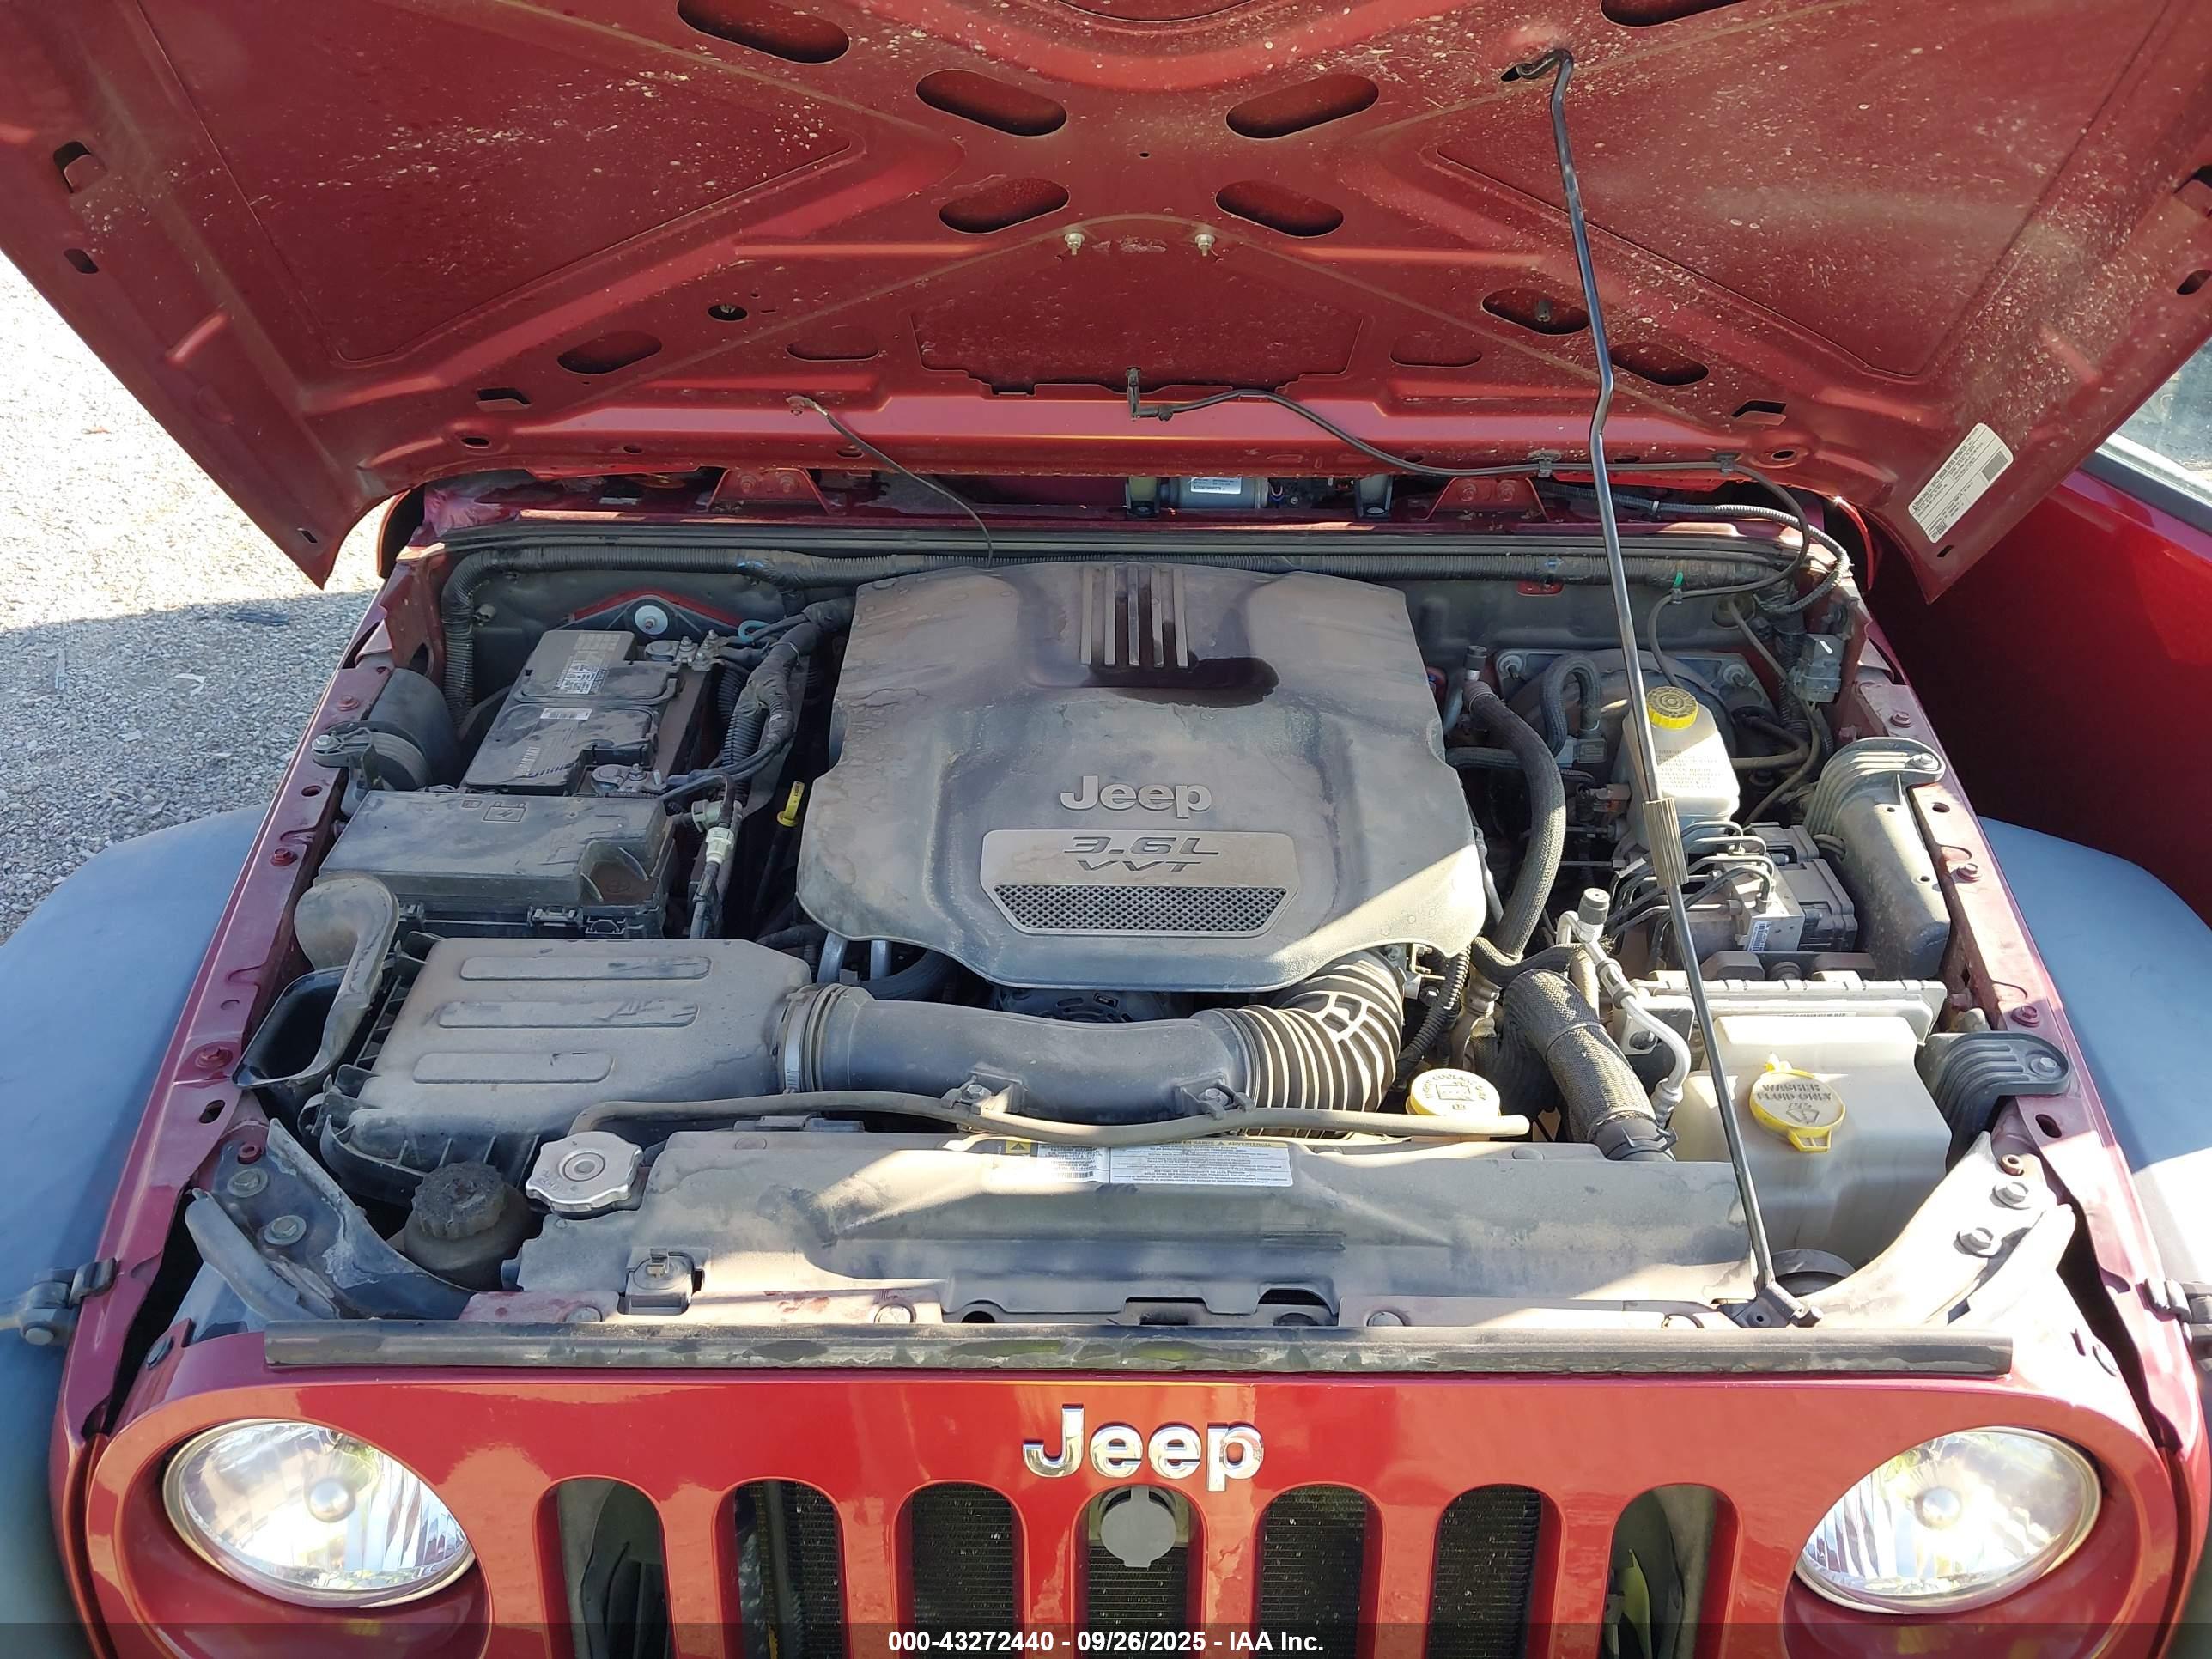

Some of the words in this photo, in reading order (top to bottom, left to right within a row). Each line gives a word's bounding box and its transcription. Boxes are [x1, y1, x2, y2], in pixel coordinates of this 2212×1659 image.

[1060, 775, 1212, 819] Jeep
[1064, 836, 1220, 856] 3.6L
[1077, 860, 1203, 873] VVT
[1761, 1084, 1821, 1092] WASHER
[1757, 1092, 1796, 1101] FLUID
[1798, 1092, 1832, 1101] ONLY
[1023, 1403, 1264, 1492] Jeep
